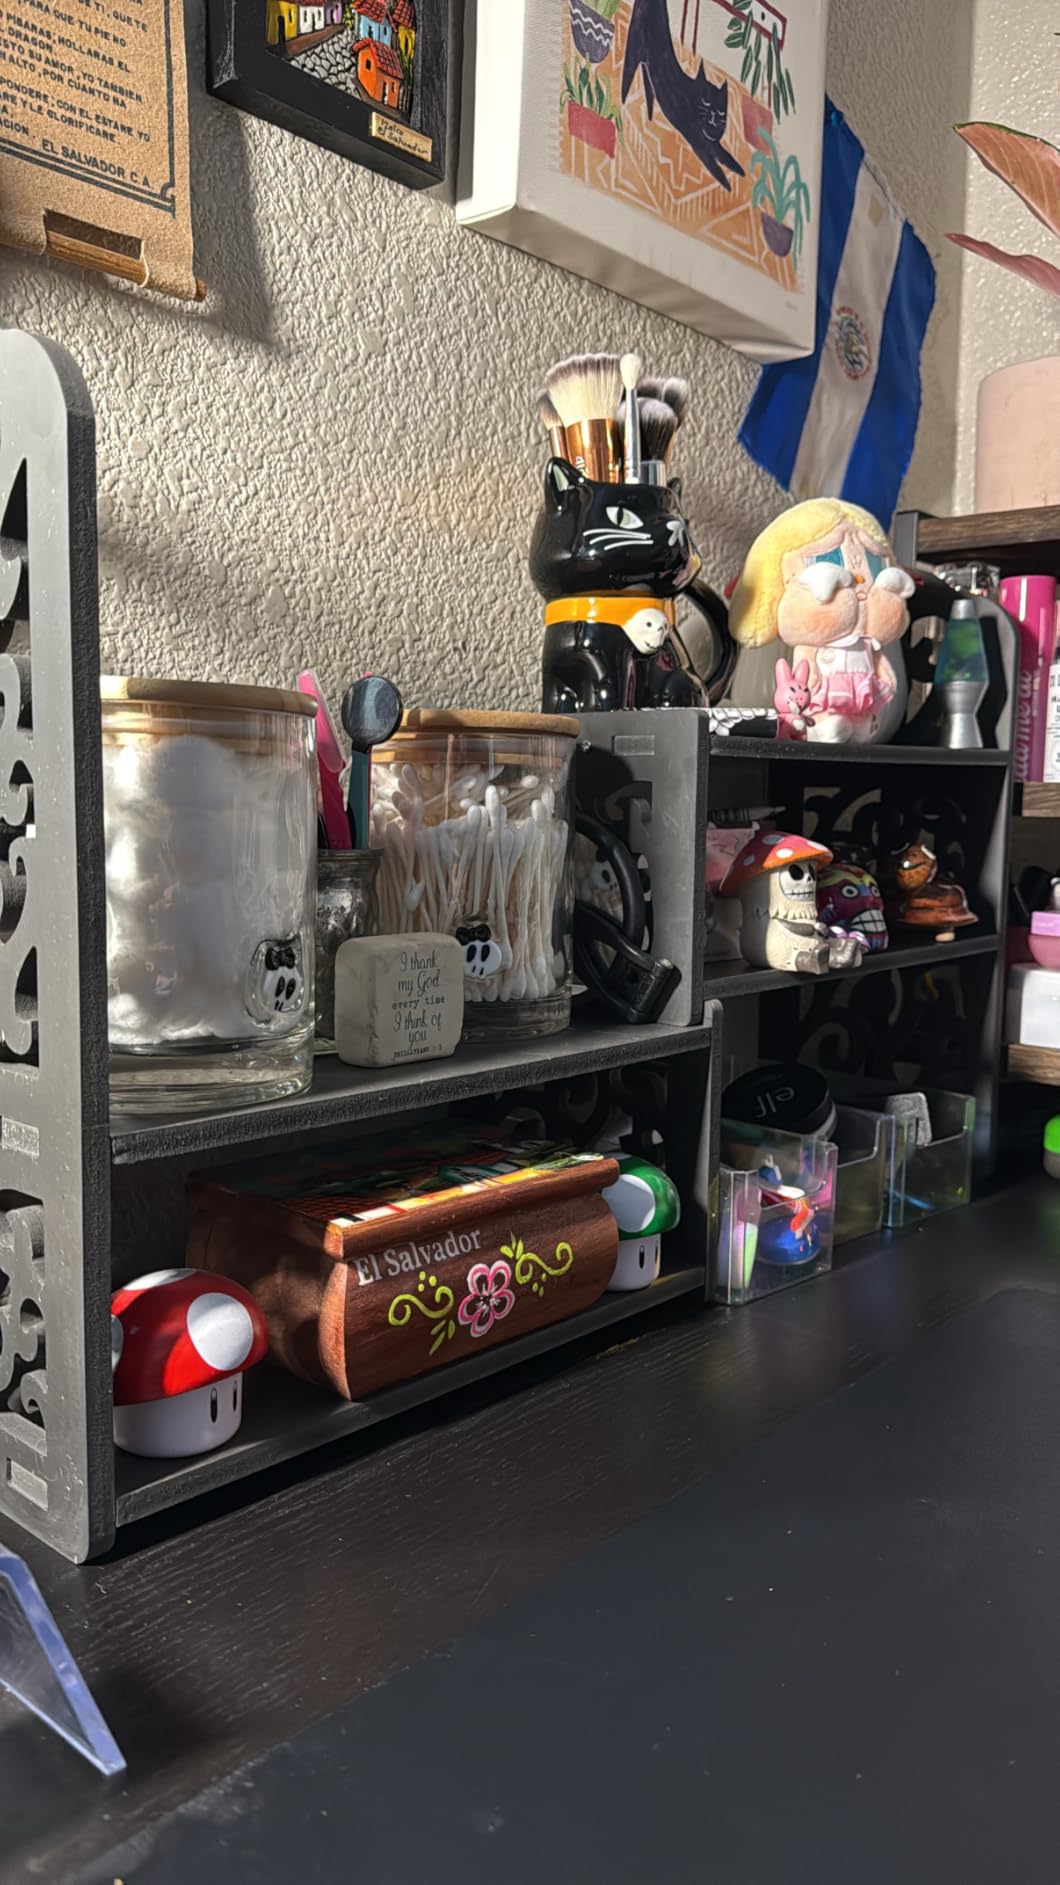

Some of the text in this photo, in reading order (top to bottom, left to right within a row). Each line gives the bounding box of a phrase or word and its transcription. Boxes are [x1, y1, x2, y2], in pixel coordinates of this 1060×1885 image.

[53, 9, 75, 26] QUE
[78, 19, 92, 33] TU
[94, 26, 110, 41] PIE
[112, 10, 133, 26] QUE
[134, 19, 148, 32] TE
[57, 35, 114, 66] HOLLARAS
[117, 60, 130, 73] EL
[0, 37, 25, 55] STO
[28, 49, 42, 62] SU
[97, 77, 143, 102] TAMBIEN
[67, 79, 110, 101] CUANTO
[20, 97, 28, 109] Y
[29, 102, 44, 116] LE
[56, 99, 77, 115] CON
[79, 108, 92, 121] EL
[95, 113, 134, 137] ESTARE
[136, 130, 150, 143] YO
[42, 139, 58, 155] EL
[61, 145, 125, 178] SALVADOR
[400, 949, 437, 972] I thank
[398, 968, 440, 997] my God
[392, 994, 445, 1010] every time
[394, 1009, 442, 1032] I think of
[408, 1030, 427, 1049] you
[754, 1086, 795, 1118] elf
[352, 1229, 481, 1287] El Salvador
